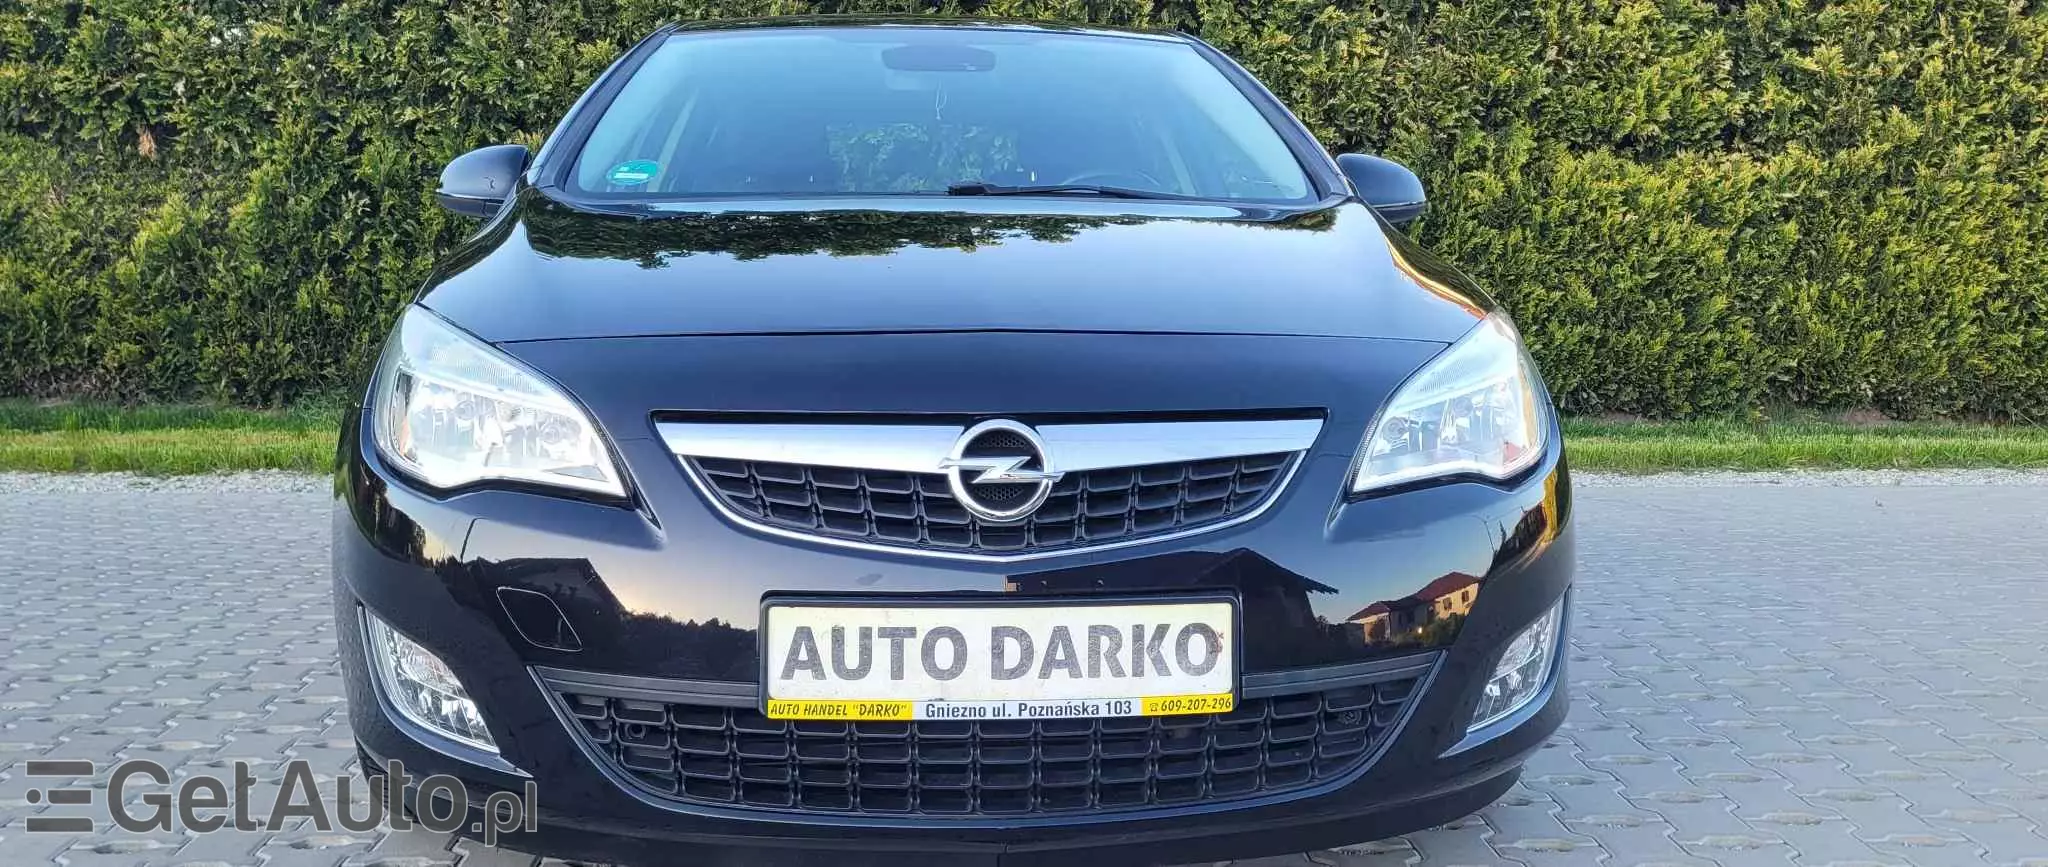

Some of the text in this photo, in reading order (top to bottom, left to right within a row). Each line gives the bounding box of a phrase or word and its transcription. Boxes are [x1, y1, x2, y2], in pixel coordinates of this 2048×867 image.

[780, 622, 1220, 681] AUTO DARKO
[770, 704, 800, 717] AUTO
[804, 704, 848, 717] HANDEL
[925, 701, 1132, 718] Gniezno ul. Poznańska 103
